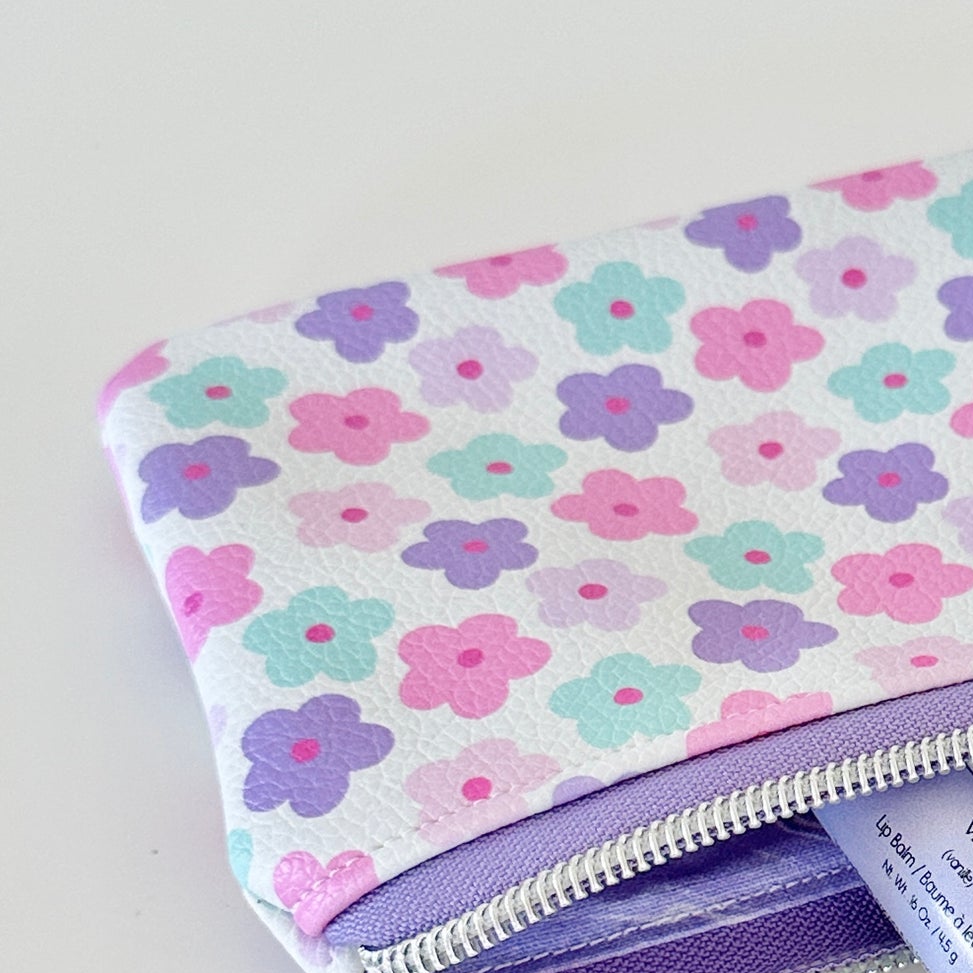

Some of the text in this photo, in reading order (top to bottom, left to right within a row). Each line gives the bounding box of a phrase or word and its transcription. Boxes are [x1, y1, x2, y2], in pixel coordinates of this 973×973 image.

[876, 814, 892, 838] Lip
[890, 832, 916, 868] Balm
[911, 865, 925, 877] /
[920, 871, 955, 916] Baume
[953, 914, 966, 928] à
[949, 951, 959, 966] g
